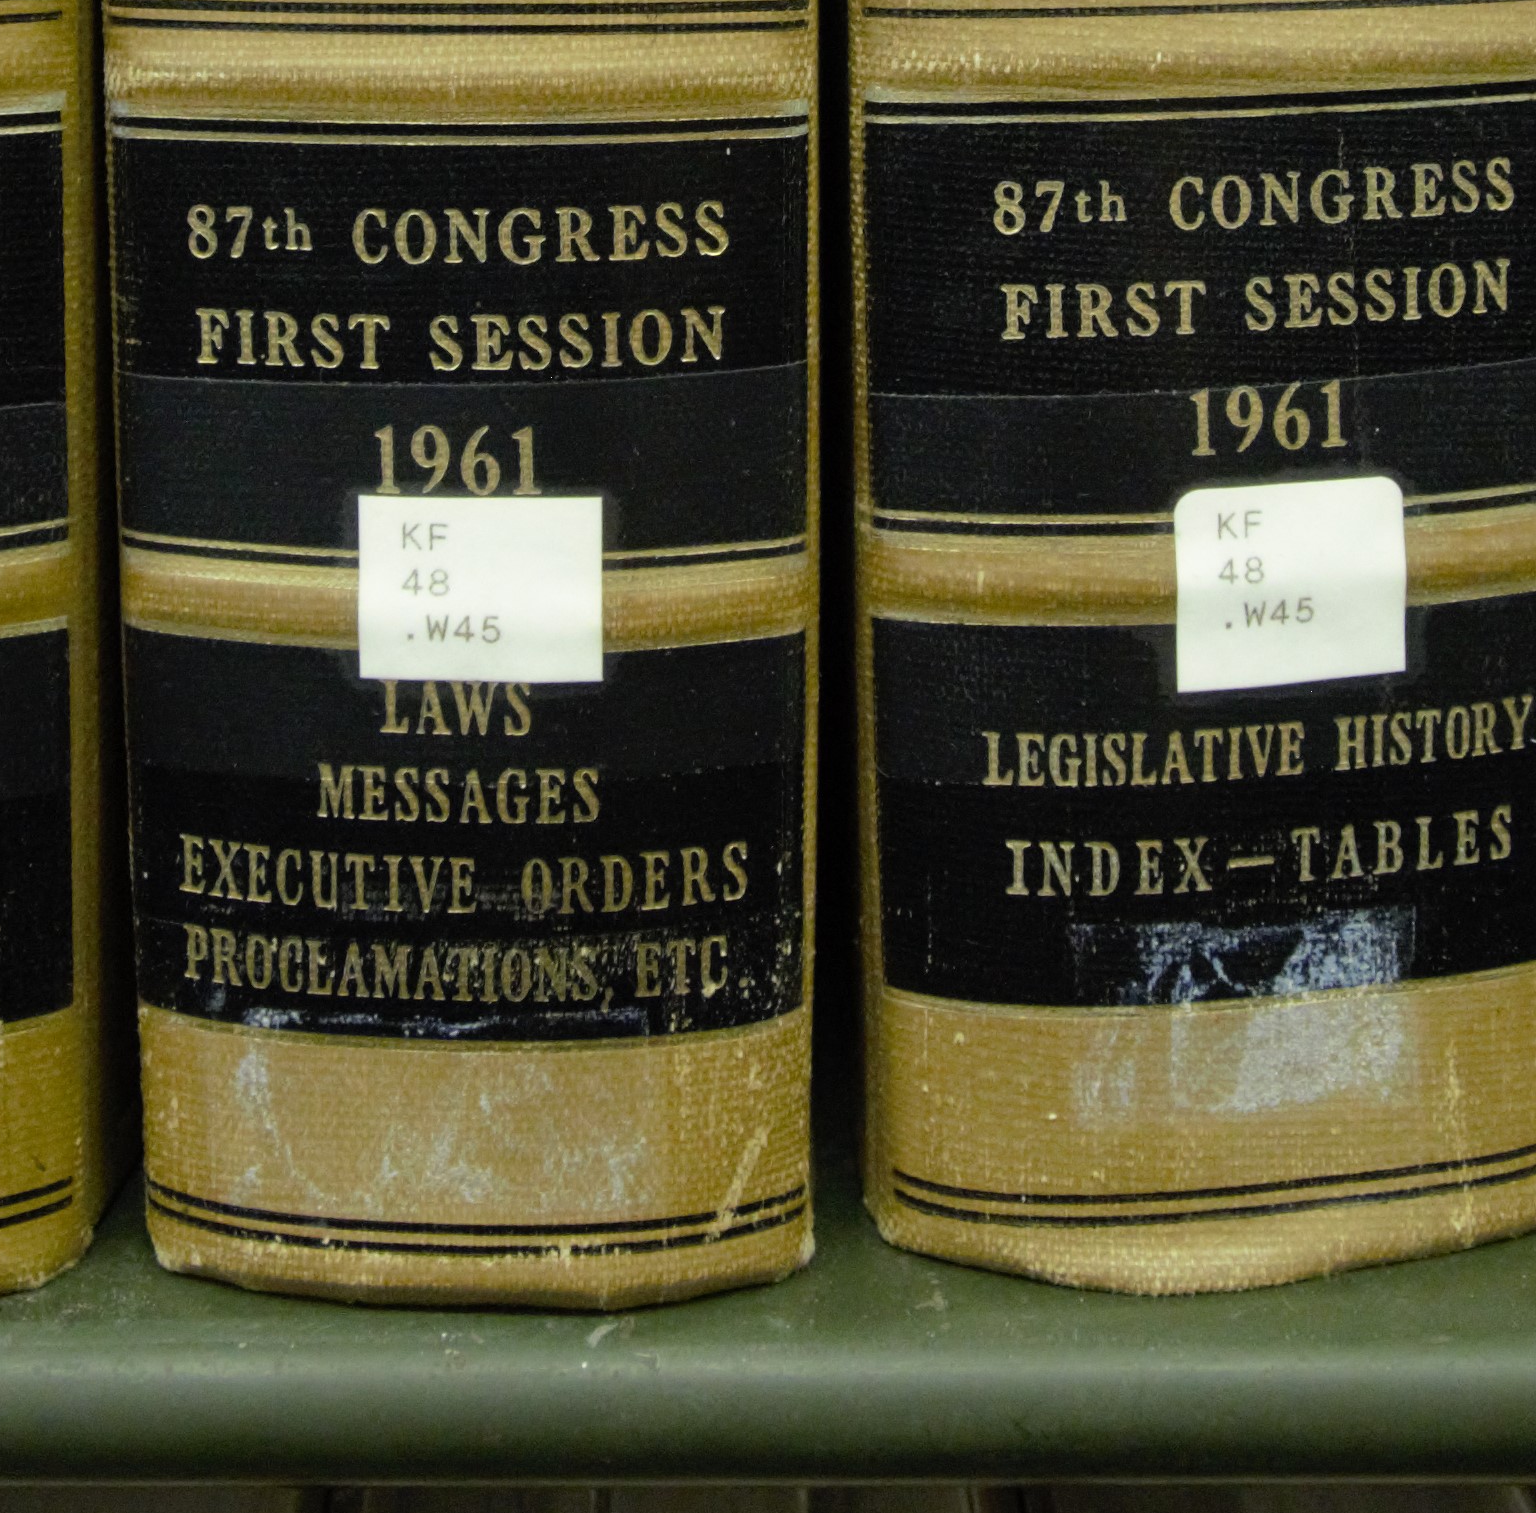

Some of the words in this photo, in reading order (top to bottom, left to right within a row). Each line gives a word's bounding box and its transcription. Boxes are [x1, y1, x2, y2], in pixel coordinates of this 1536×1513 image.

[992, 181, 1128, 236] 87th
[1169, 156, 1516, 232] CONGRESS
[186, 205, 313, 260] 87th
[353, 200, 730, 266] CONGRESS
[1000, 281, 1207, 341] FIRST
[1244, 257, 1511, 333] SESSION
[195, 307, 391, 371] FIRST
[429, 306, 727, 372] SESSION
[1189, 380, 1349, 458] 1961
[374, 425, 542, 497] 1961
[401, 523, 449, 550] KF
[1217, 510, 1263, 541] KF
[402, 569, 450, 597] 48
[1217, 556, 1265, 586] 48
[405, 615, 503, 645] .W45
[1224, 598, 1315, 631] .W45
[379, 679, 532, 736] LAWS
[982, 721, 1305, 789] LEGISLATIVE
[1333, 695, 1536, 773] HISTORY
[316, 762, 601, 826] MESSAGES
[178, 833, 476, 915] EXECUTIVE
[522, 840, 749, 916] ORDERS
